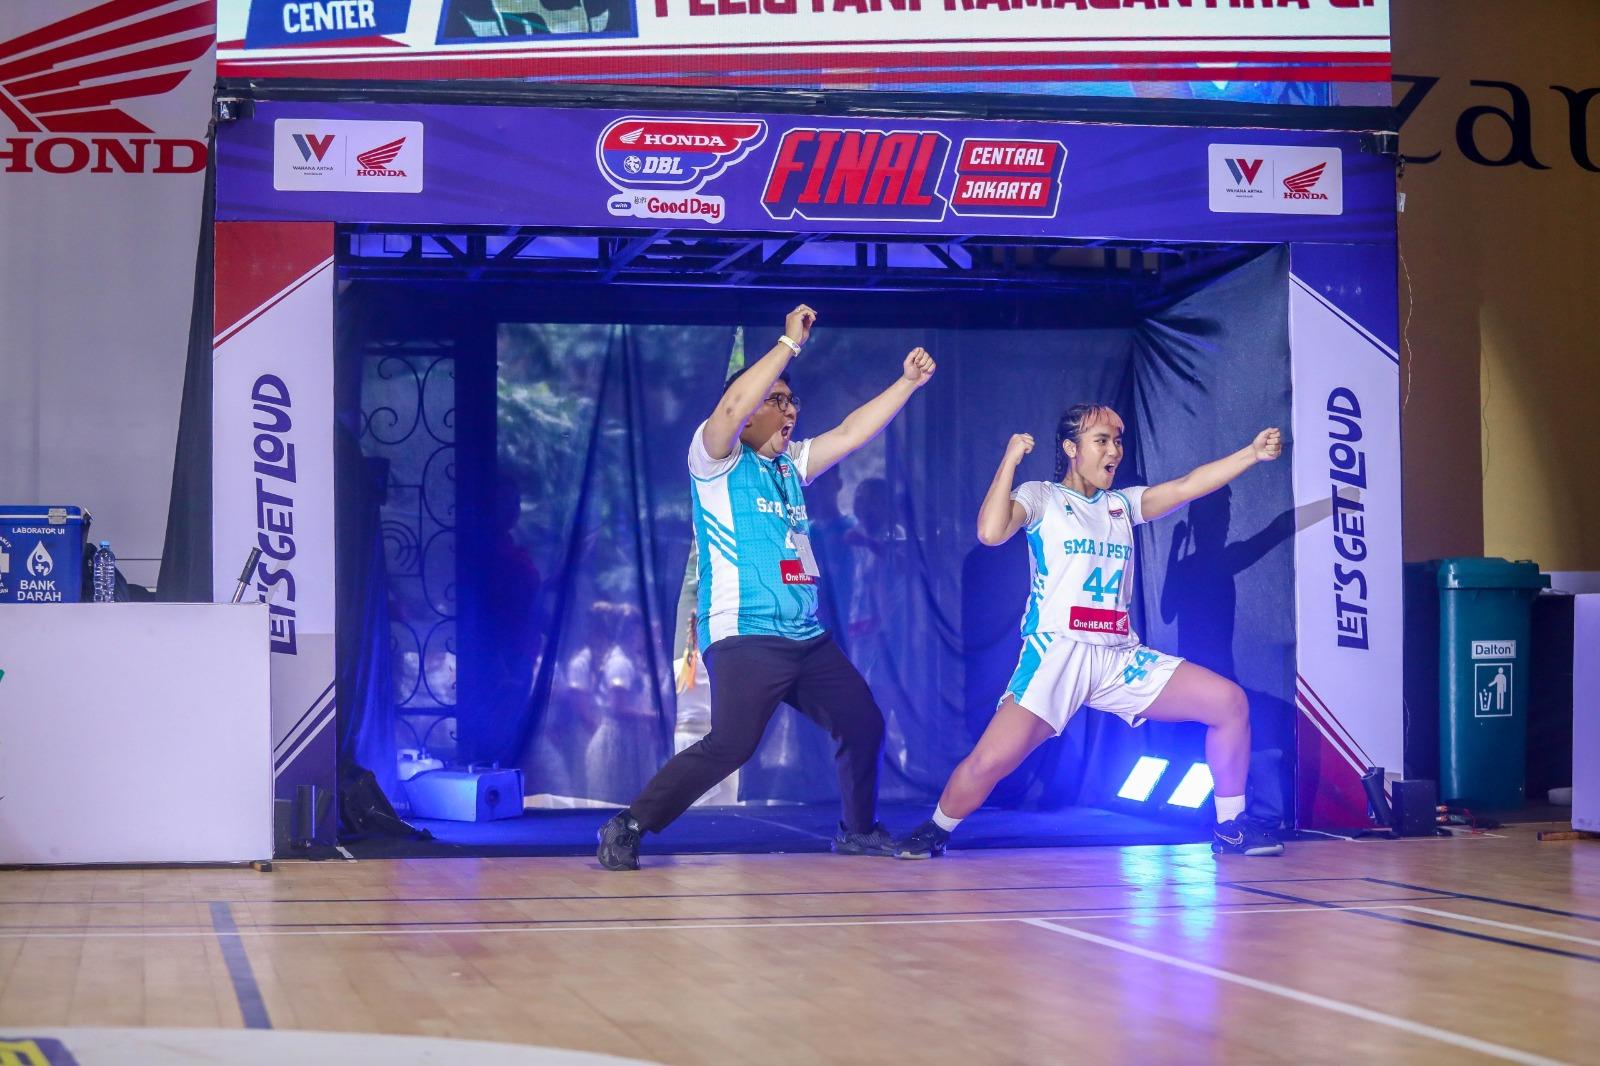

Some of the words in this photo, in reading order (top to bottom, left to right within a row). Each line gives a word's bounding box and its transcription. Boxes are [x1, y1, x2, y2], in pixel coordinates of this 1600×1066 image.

[283, 0, 376, 33] CENTER
[644, 134, 727, 147] HONDA
[642, 156, 684, 175] DBL
[969, 146, 1045, 167] CENTRAL
[356, 169, 407, 177] HONDA
[764, 130, 940, 206] FINAL
[962, 180, 1043, 200] JAKARTA
[1283, 192, 1328, 200] HONDA
[647, 197, 688, 214] Good
[689, 198, 720, 218] Day
[251, 373, 298, 484] LOUD
[1326, 387, 1367, 490] LOUD
[256, 477, 297, 561] GET
[1331, 484, 1367, 562] GET
[1064, 538, 1096, 555] SMA
[1098, 542, 1104, 557] 1
[20, 579, 56, 591] BANK
[785, 572, 799, 582] One
[1082, 566, 1123, 603] 44
[17, 591, 62, 602] DARAH
[1334, 563, 1369, 650] LET'S
[1073, 618, 1088, 629] One
[1475, 644, 1511, 655] Dalton
[1123, 649, 1160, 685] 44
